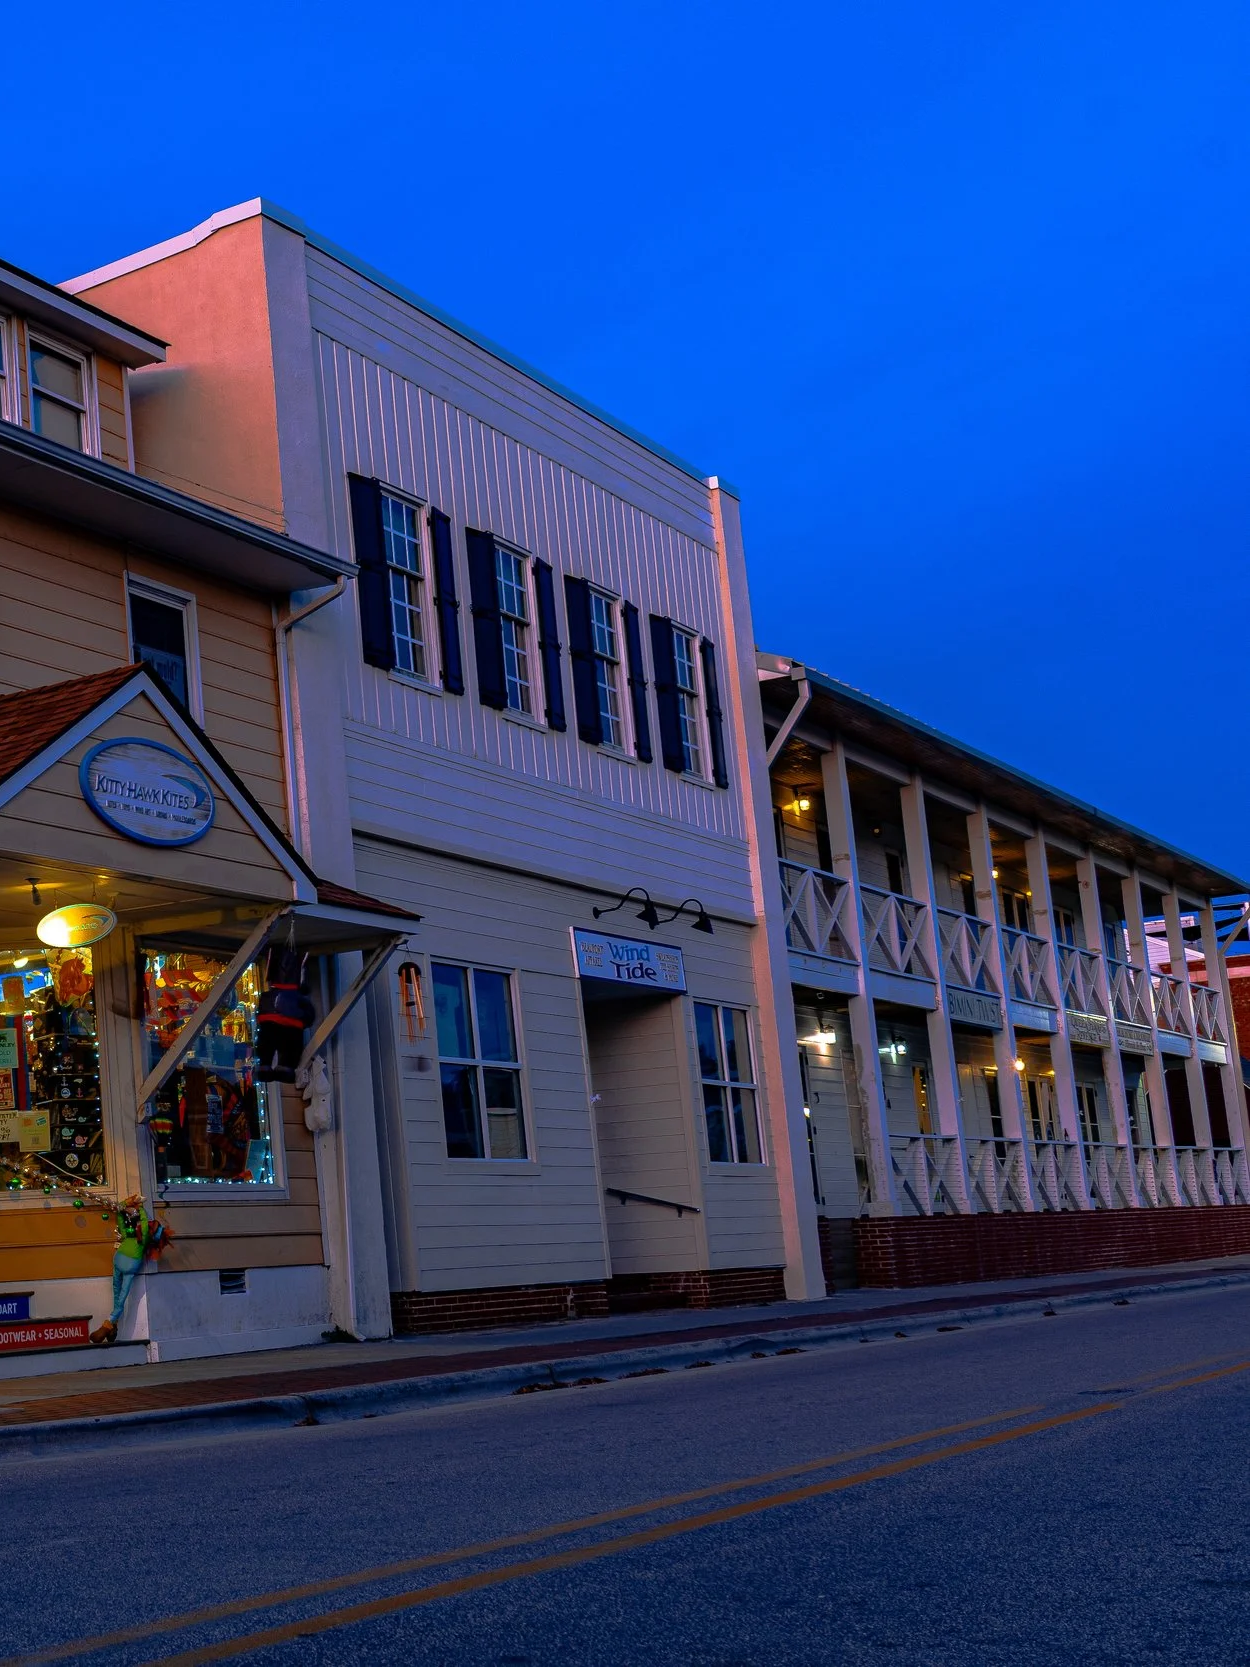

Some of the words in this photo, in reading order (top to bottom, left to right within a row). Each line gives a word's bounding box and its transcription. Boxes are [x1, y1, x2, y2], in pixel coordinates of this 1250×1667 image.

[95, 774, 127, 796] KITTY
[126, 781, 160, 804] HAWK
[160, 789, 190, 810] KITES
[606, 941, 651, 962] Wind
[610, 960, 658, 982] Tide
[976, 999, 999, 1023] TWIST
[44, 1326, 84, 1341] SEASONAL
